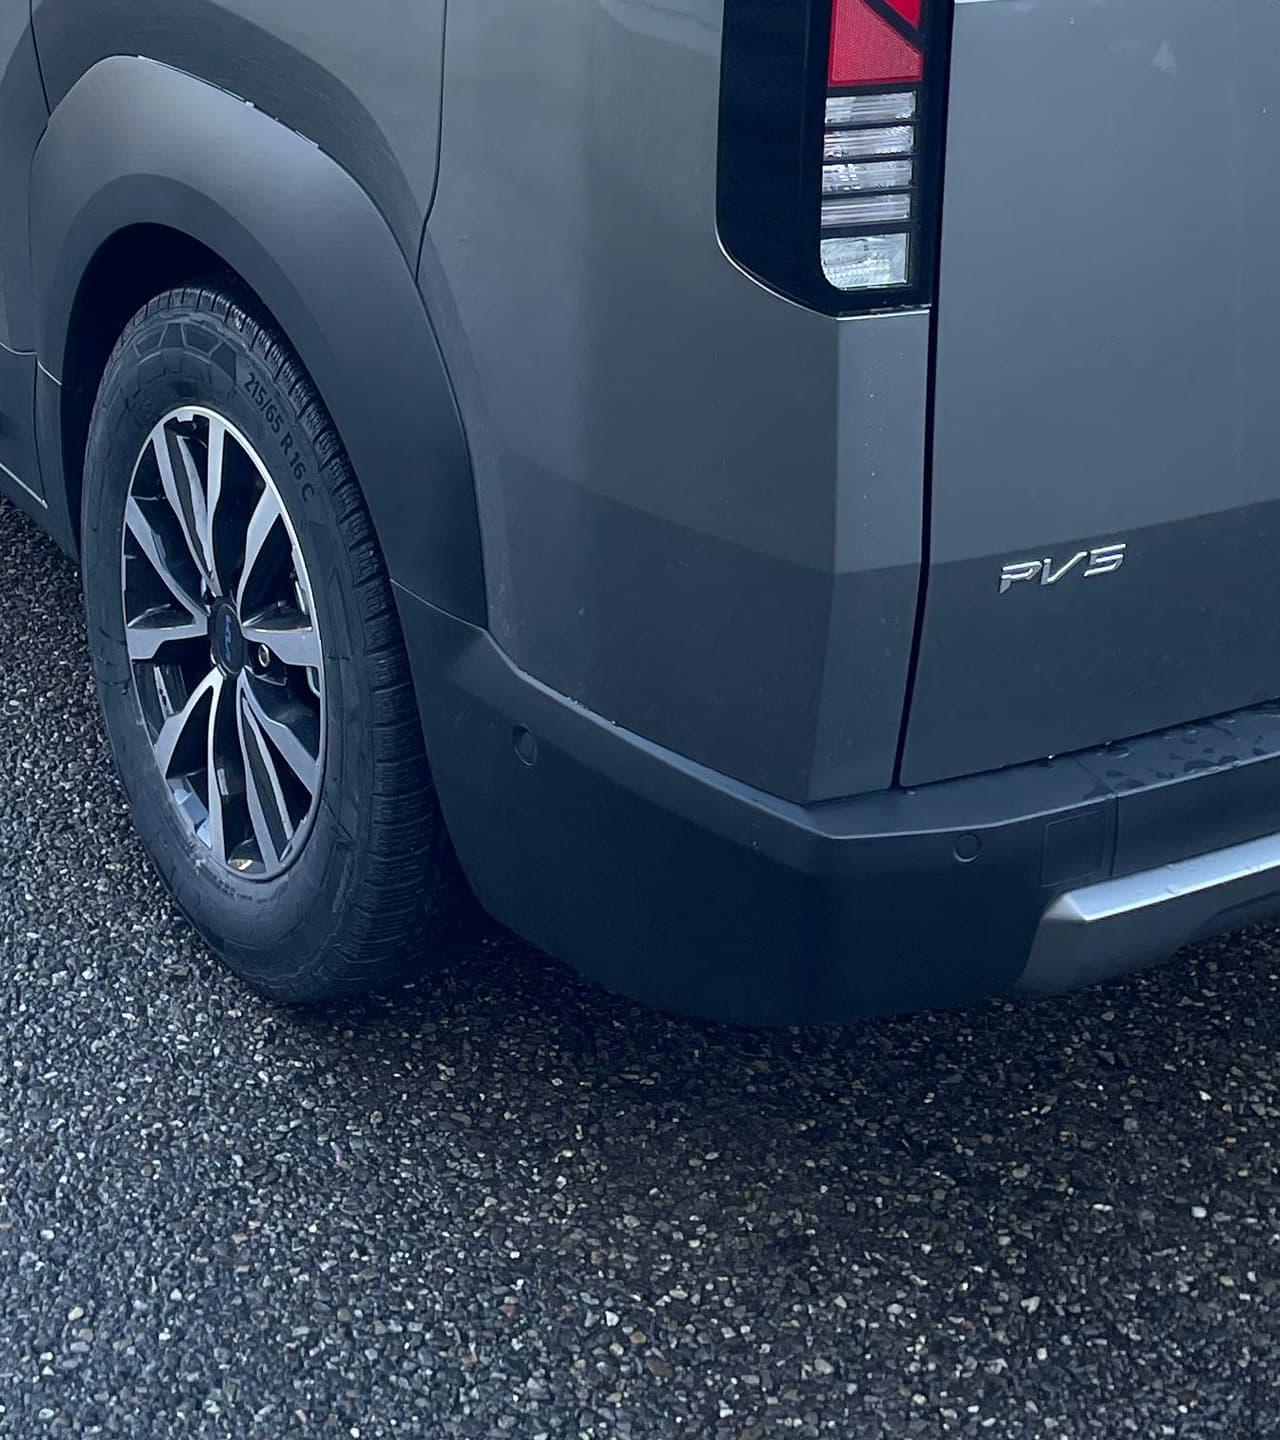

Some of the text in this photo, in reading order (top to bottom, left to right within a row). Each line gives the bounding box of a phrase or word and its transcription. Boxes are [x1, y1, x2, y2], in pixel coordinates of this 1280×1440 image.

[244, 371, 284, 433] 215/65
[301, 482, 315, 502] C
[999, 543, 1127, 594] PV5
